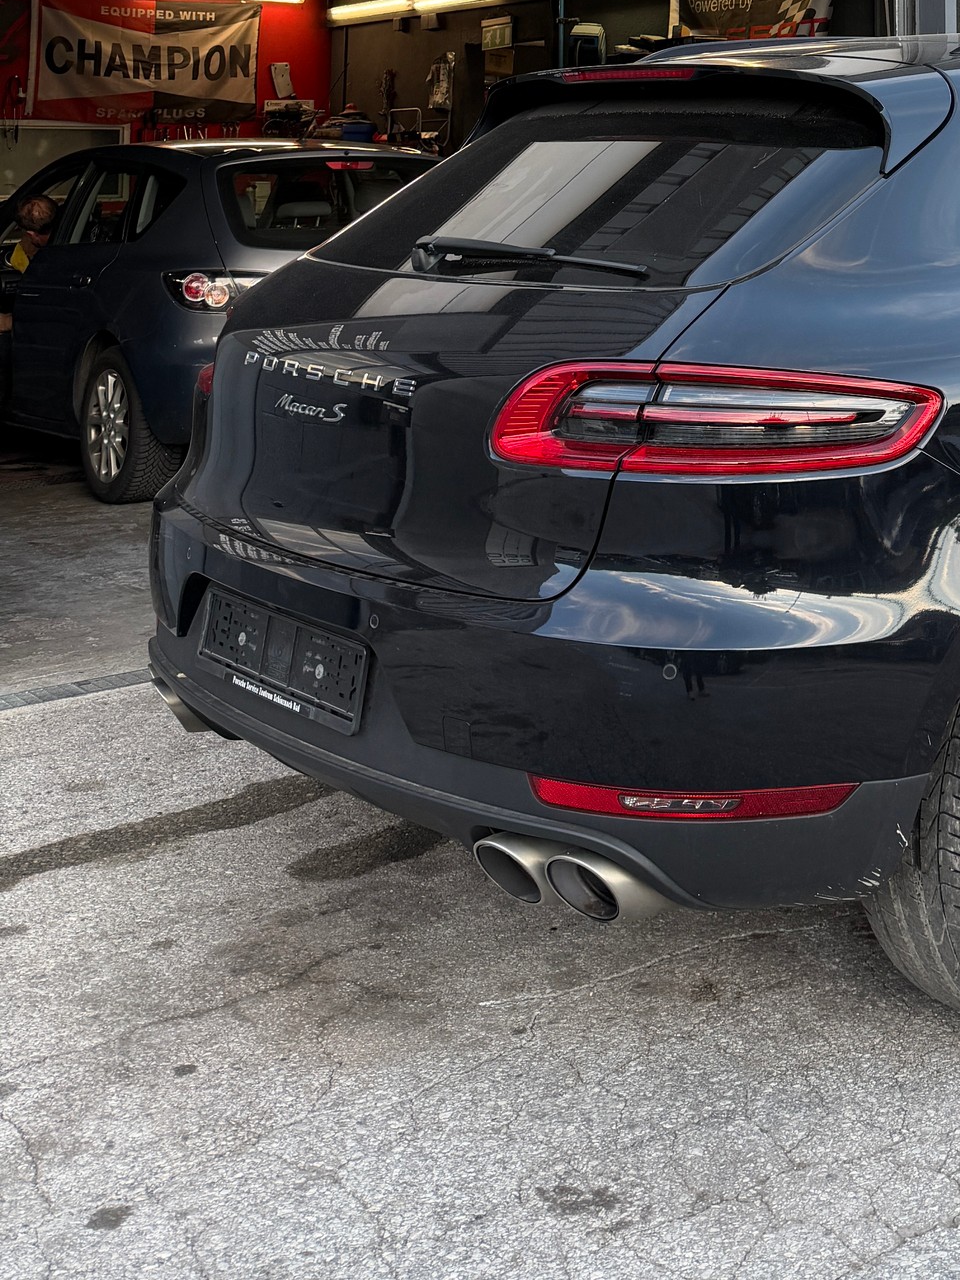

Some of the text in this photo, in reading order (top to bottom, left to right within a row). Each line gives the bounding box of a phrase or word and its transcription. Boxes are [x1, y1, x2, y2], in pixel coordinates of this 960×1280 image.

[100, 5, 216, 22] EQUIPPED WITH
[44, 35, 251, 81] CHAMPION
[244, 350, 417, 397] PORSCHE
[274, 393, 348, 422] Macan S
